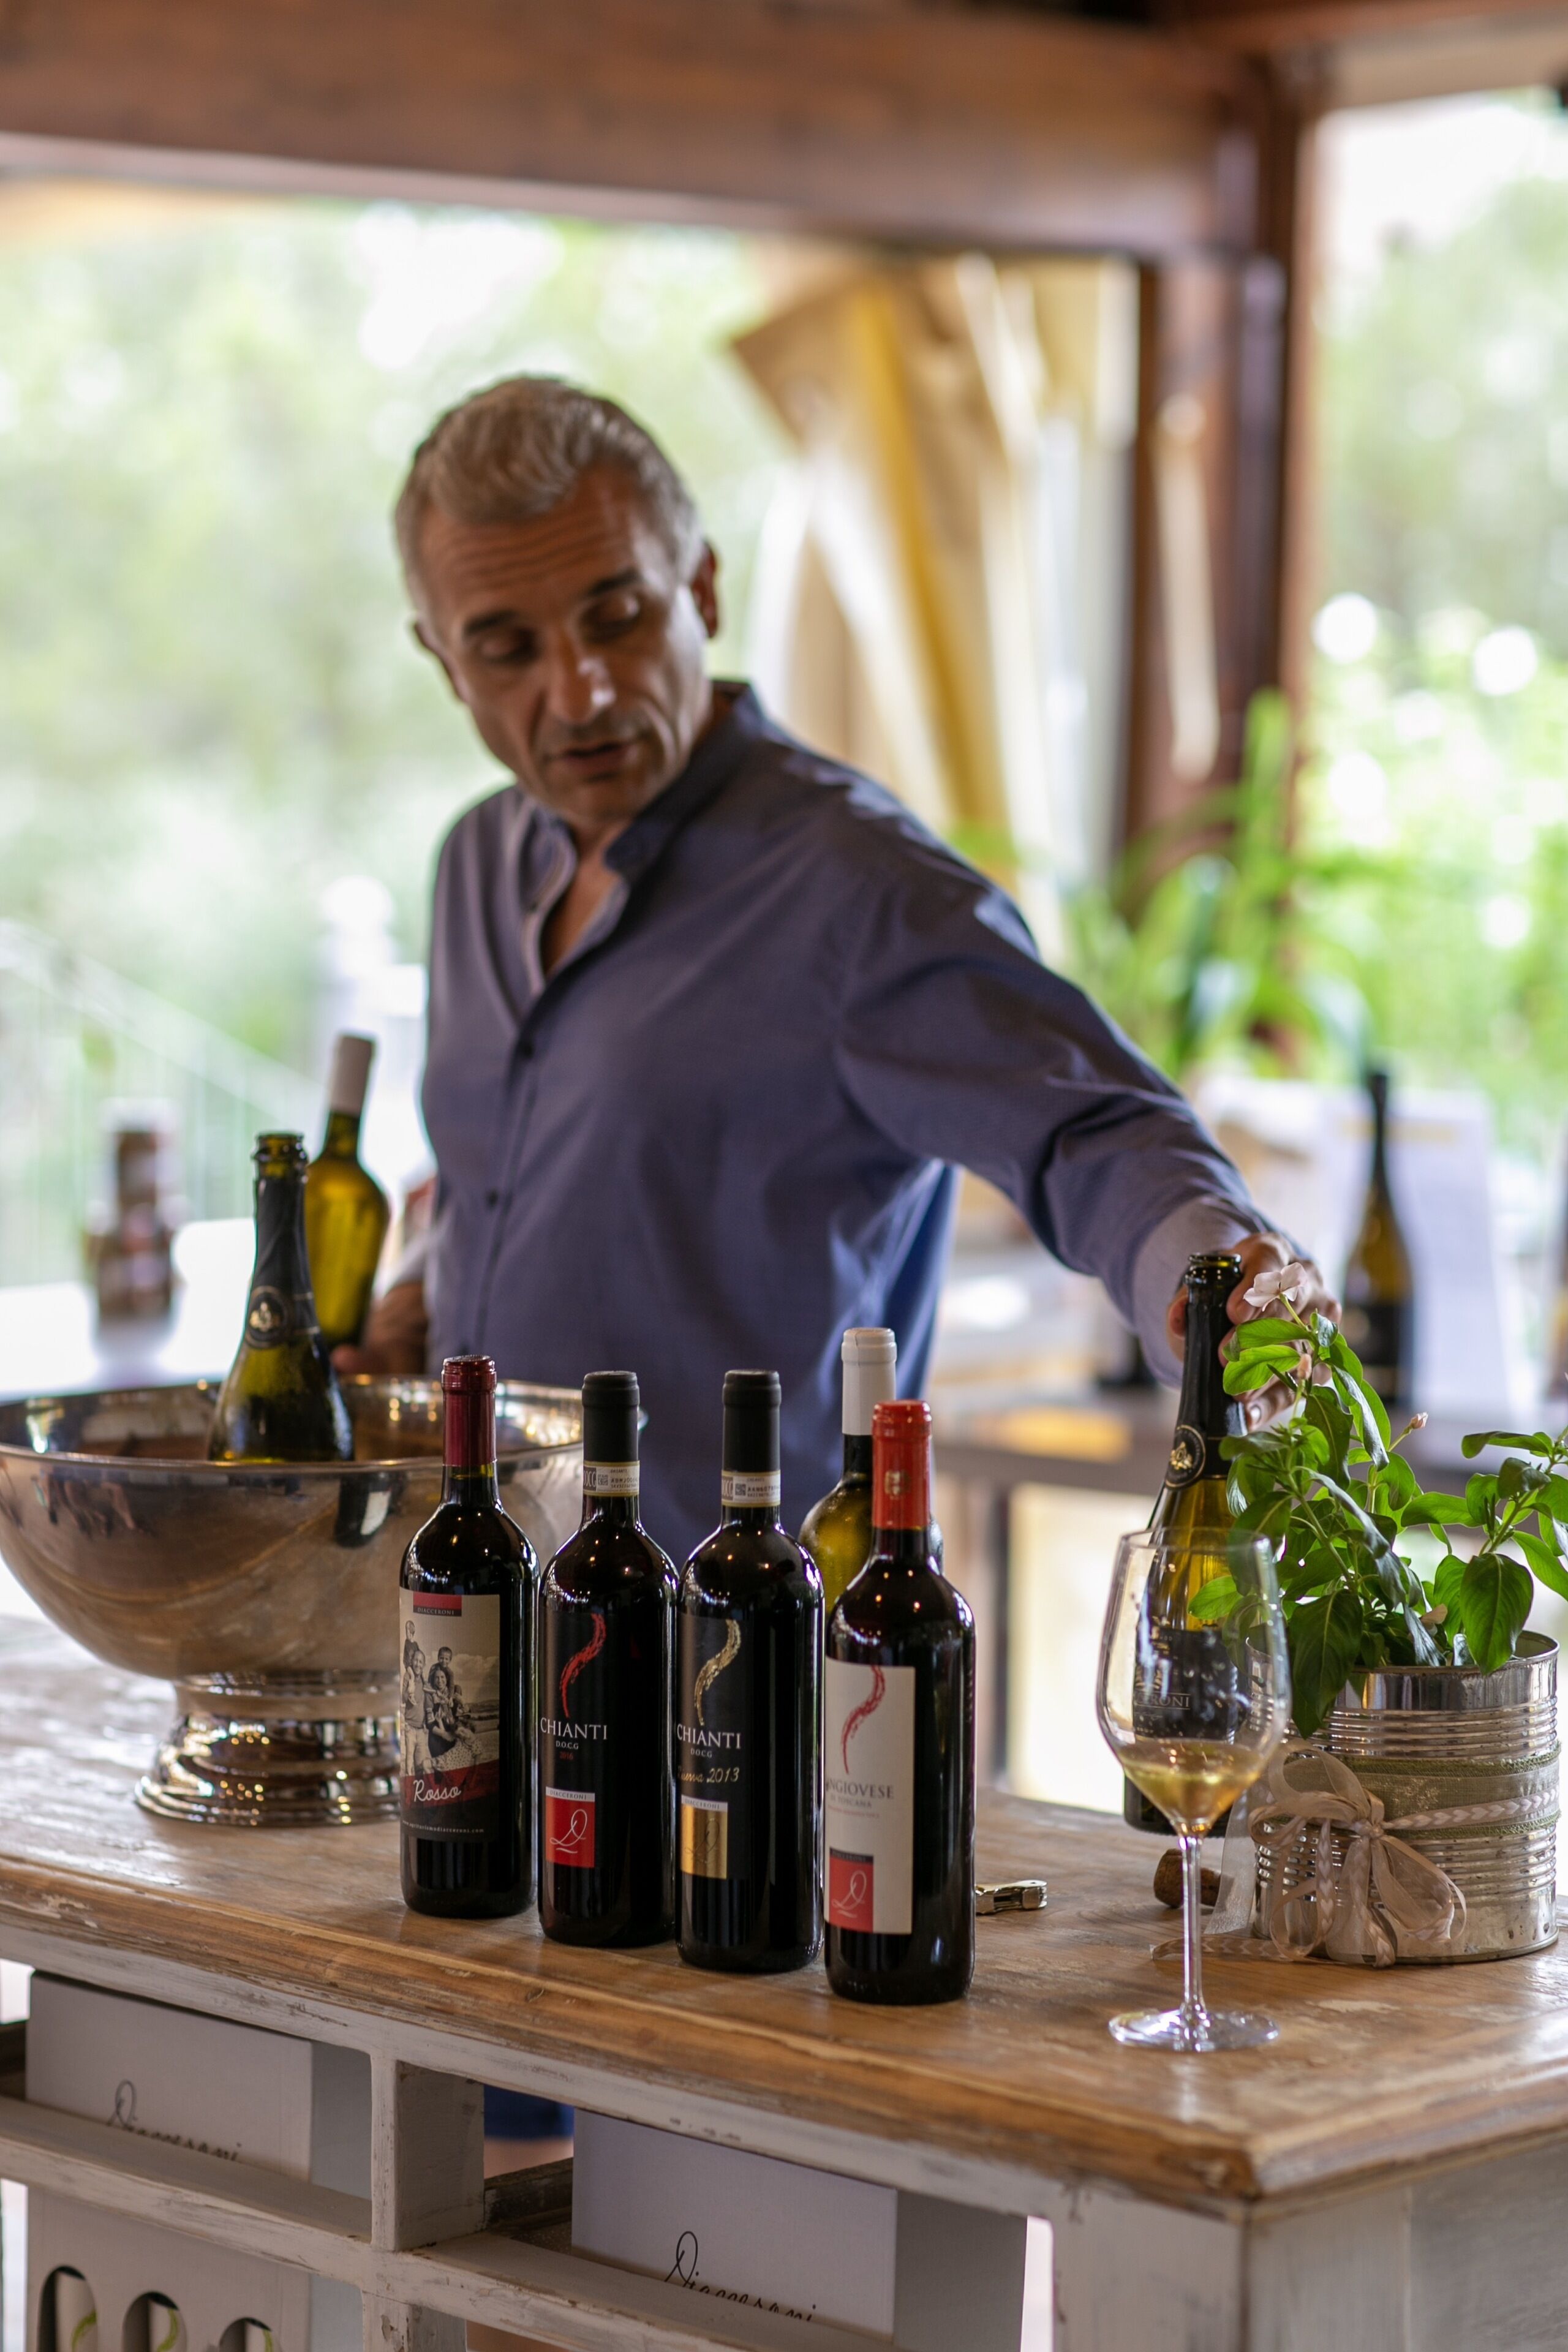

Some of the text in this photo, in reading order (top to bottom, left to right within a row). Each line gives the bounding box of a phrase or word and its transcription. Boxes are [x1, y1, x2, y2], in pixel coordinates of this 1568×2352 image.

[540, 1717, 608, 1740] CHIANTI
[677, 1723, 741, 1749] CHIANTI
[690, 1747, 712, 1758] DOCG
[706, 1766, 740, 1783] 2013
[413, 1779, 462, 1803] Rosso
[550, 1790, 587, 1800] DIACCERONI
